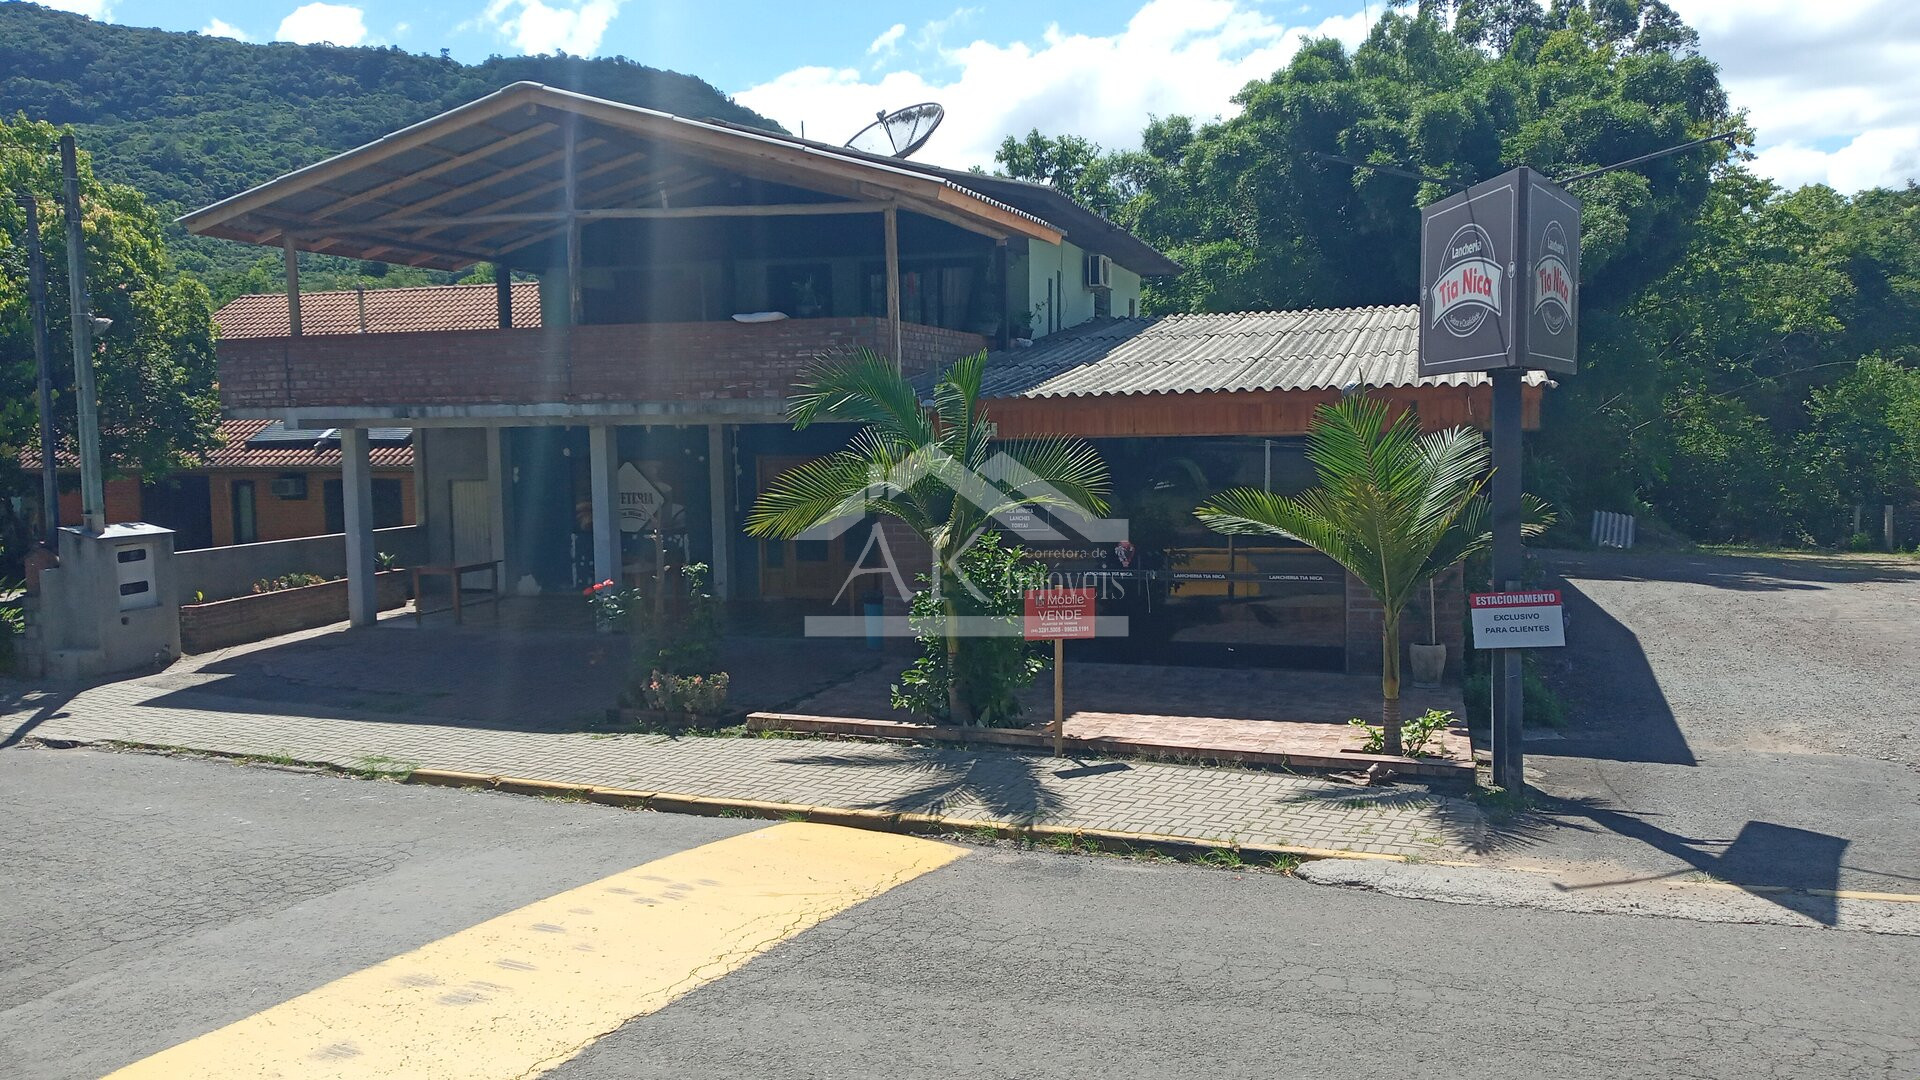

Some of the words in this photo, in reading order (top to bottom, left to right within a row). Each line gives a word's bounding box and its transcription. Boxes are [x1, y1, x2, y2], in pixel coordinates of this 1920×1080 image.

[1452, 240, 1482, 259] Lancheria
[1439, 279, 1459, 308] Tia
[1462, 267, 1492, 297] Nica
[1539, 267, 1551, 296] Tia
[1554, 267, 1568, 304] Nica
[1047, 595, 1085, 605] Mobile
[1475, 593, 1556, 606] ESTACIONAMENTO
[1038, 609, 1082, 621] VENDE
[1493, 613, 1540, 621] EXCLUSIVO
[1485, 626, 1508, 634] PARA
[1509, 625, 1550, 633] CLIENTES
